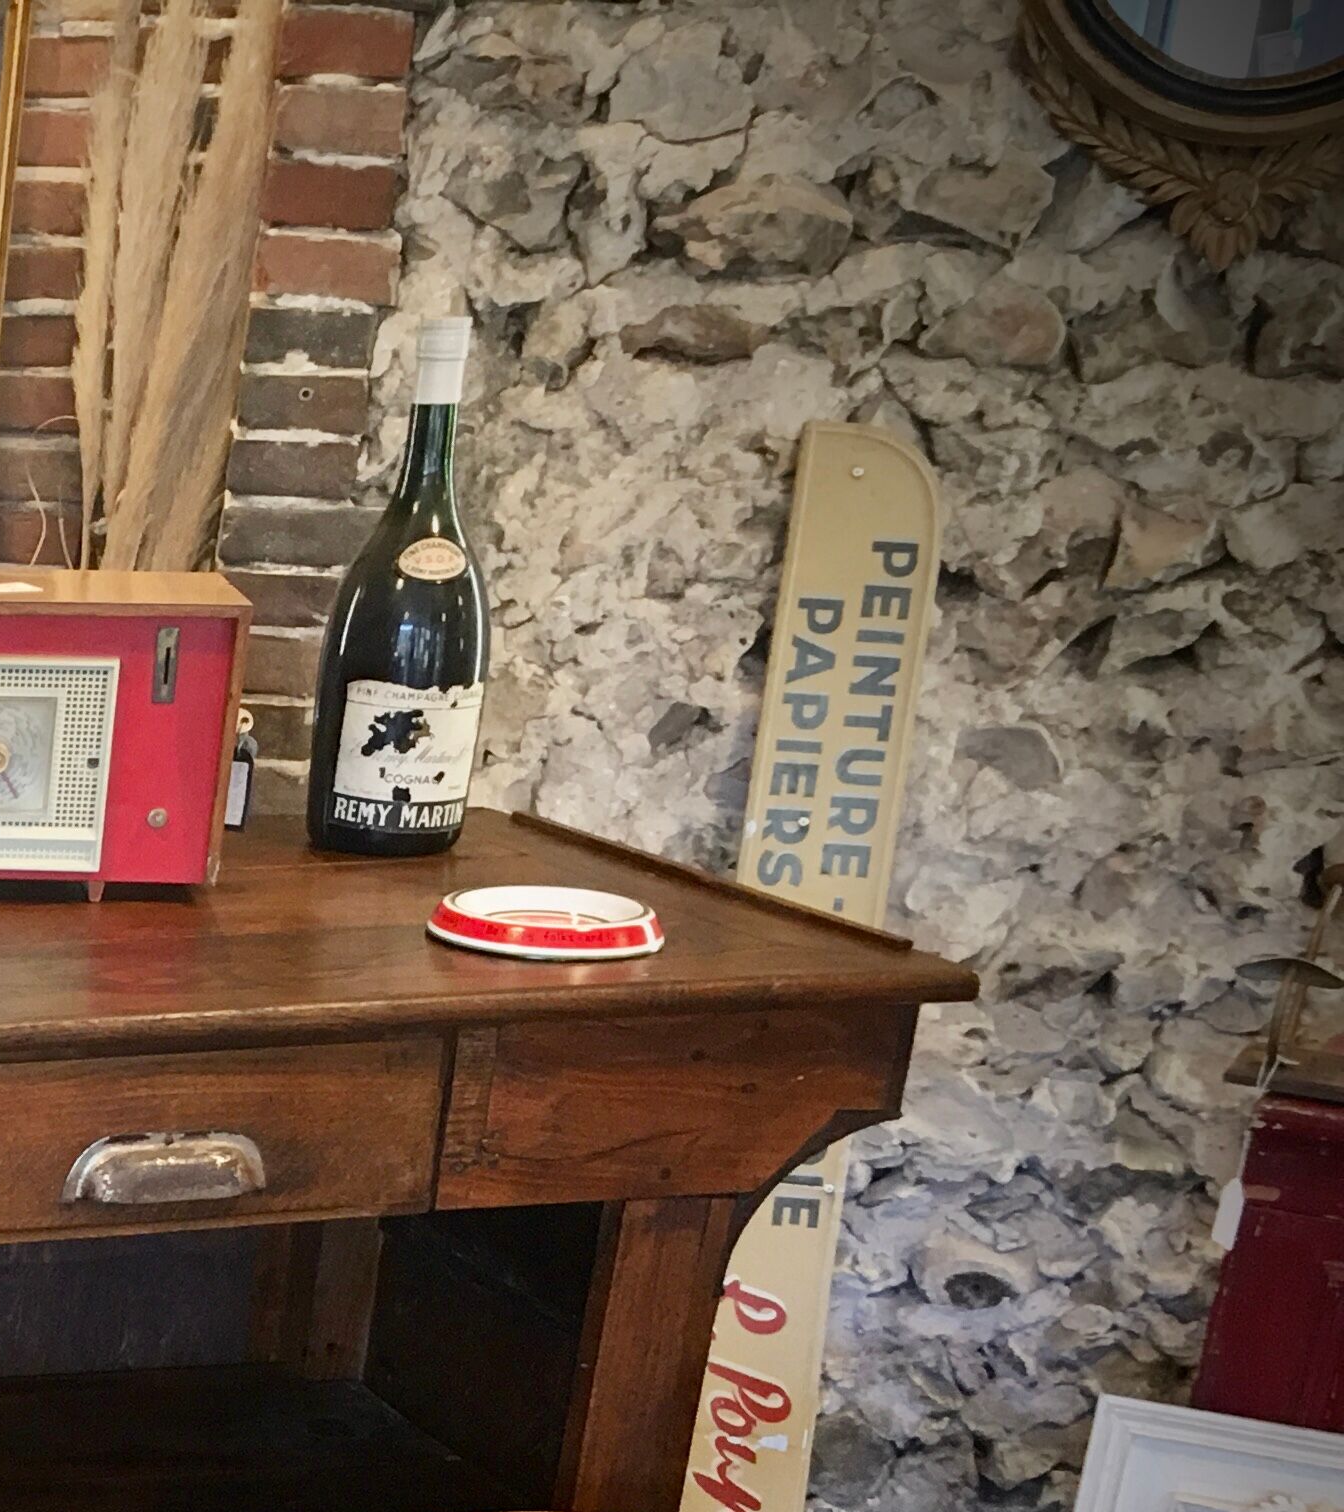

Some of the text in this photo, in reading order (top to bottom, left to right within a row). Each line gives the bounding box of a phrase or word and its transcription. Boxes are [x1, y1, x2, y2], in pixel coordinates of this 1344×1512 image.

[334, 797, 463, 828] REMY MARTIN
[757, 597, 844, 887] PAPIERS
[818, 541, 919, 878] PEINTURE
